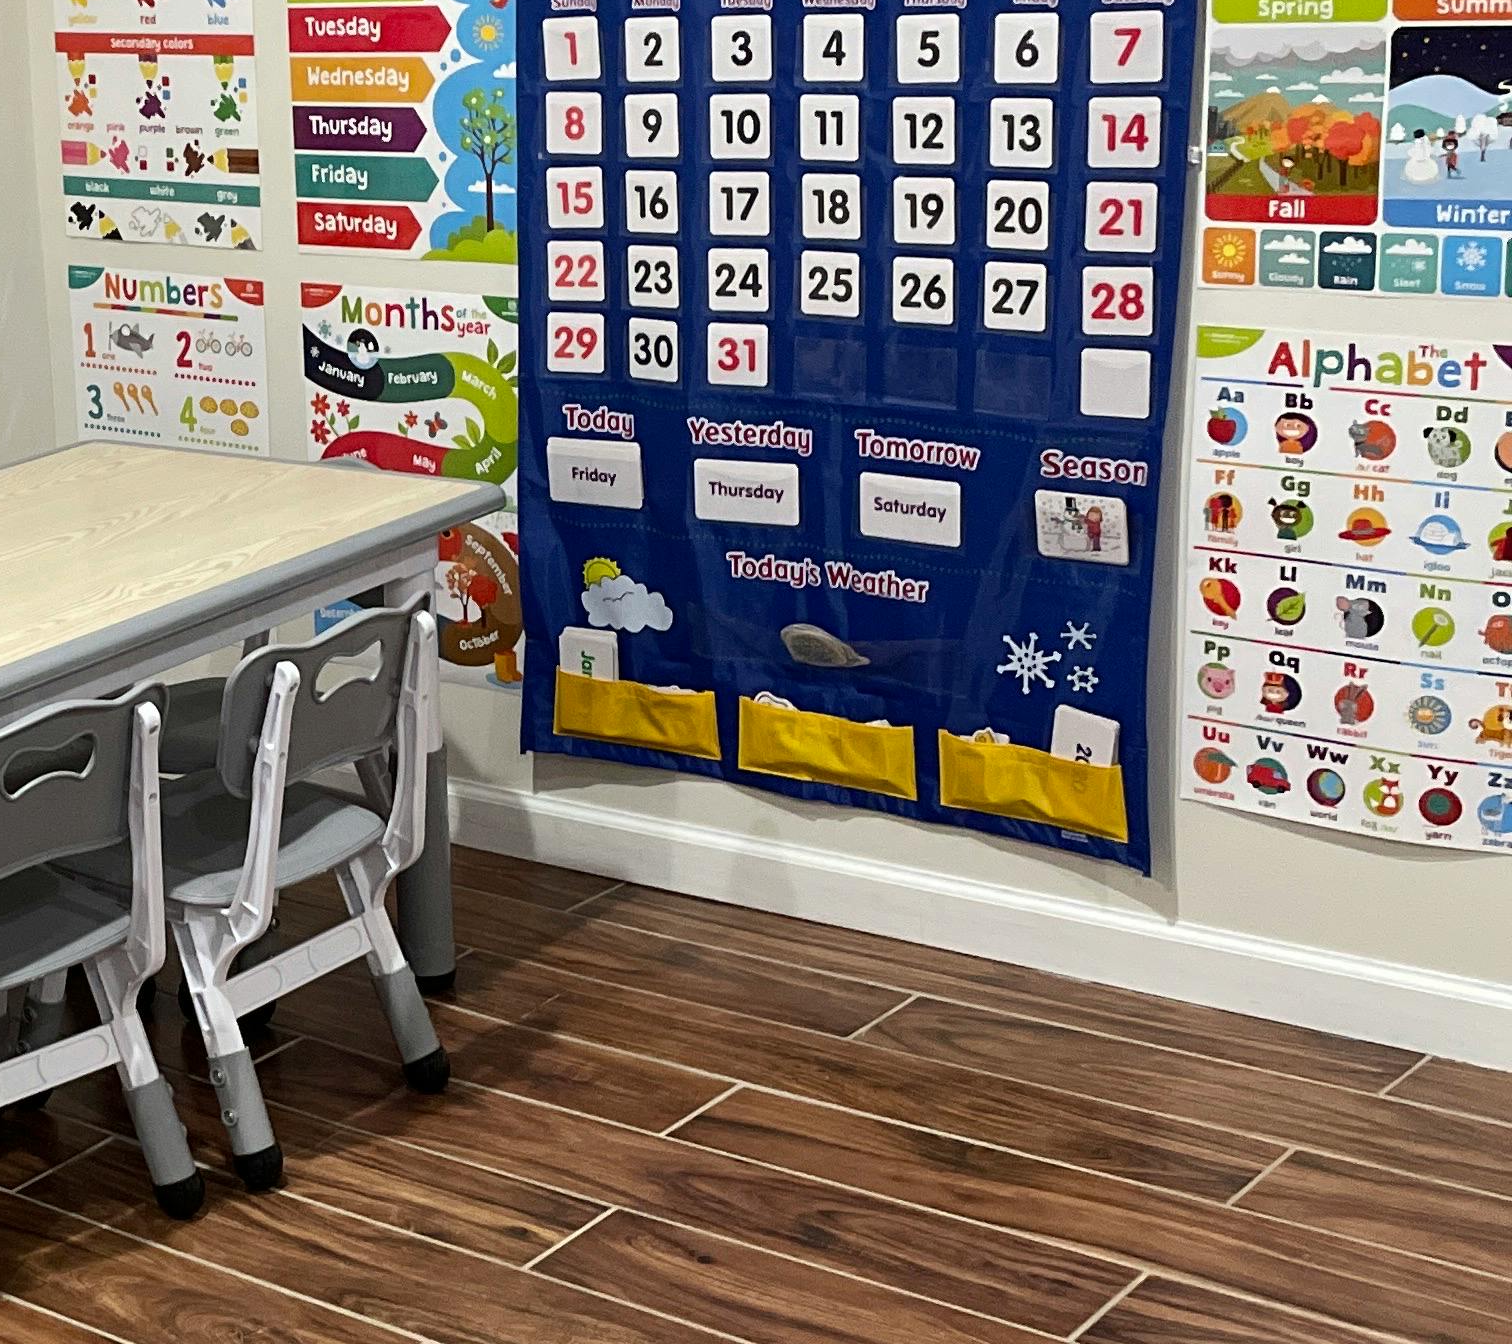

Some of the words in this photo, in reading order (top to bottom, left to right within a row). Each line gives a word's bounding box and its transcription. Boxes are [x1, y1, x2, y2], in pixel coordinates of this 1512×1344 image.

[140, 15, 156, 25] red
[207, 14, 229, 25] blue
[1258, 0, 1333, 19] Spring
[163, 38, 194, 50] colors
[305, 16, 381, 43] Tuesday
[564, 32, 577, 65] 1
[644, 32, 663, 66] 2
[731, 31, 752, 66] 3
[823, 30, 846, 66] 4
[917, 30, 940, 67] 5
[1015, 30, 1039, 67] 6
[1114, 28, 1141, 66] 7
[307, 66, 410, 93] Wednesday
[139, 124, 166, 136] purple
[175, 125, 203, 135] brown
[215, 126, 239, 138] green
[309, 115, 393, 143] Thursday
[565, 106, 584, 140] 8
[643, 109, 661, 142] 9
[720, 109, 761, 144] 10
[815, 110, 842, 145] 11
[904, 113, 944, 149] 12
[1002, 114, 1041, 151] 13
[1102, 114, 1148, 151] 14
[85, 182, 110, 194] black
[149, 185, 176, 197] white
[311, 164, 368, 191] Friday
[314, 212, 397, 239] Saturday
[556, 182, 593, 214] 15
[634, 186, 669, 220] 16
[721, 186, 758, 221] 17
[813, 189, 849, 224] 18
[905, 192, 944, 228] 19
[994, 197, 1042, 234] 20
[1100, 199, 1142, 236] 21
[1268, 199, 1305, 219] Fall
[1436, 204, 1511, 224] Winter
[105, 272, 223, 308] Numbers
[555, 255, 598, 288] 22
[634, 261, 673, 294] 23
[715, 264, 762, 297] 24
[809, 267, 852, 302] 25
[900, 273, 946, 309] 26
[992, 278, 1038, 315] 27
[1092, 284, 1145, 320] 28
[342, 296, 454, 331] Months
[456, 308, 467, 319] of
[457, 321, 491, 338] year
[83, 323, 96, 357] 1
[176, 331, 192, 368] 2
[554, 327, 598, 359] 29
[634, 335, 673, 368] 30
[717, 337, 757, 371] 31
[1419, 344, 1448, 358] The
[318, 361, 365, 387] January
[388, 371, 438, 385] February
[461, 370, 497, 400] March
[1268, 339, 1487, 391] Alphabet
[87, 385, 103, 419] 3
[180, 396, 197, 432] 4
[1217, 387, 1245, 403] Aa
[1285, 393, 1313, 410] Bb
[1365, 399, 1391, 417] Cc
[1436, 406, 1469, 424] Dd
[413, 454, 435, 473] May
[475, 447, 501, 474] April
[564, 405, 634, 439] Today
[688, 418, 812, 456] Yesterday
[855, 430, 980, 470] Tomorrow
[1041, 450, 1148, 486] Season
[572, 467, 616, 486] Friday
[709, 481, 784, 503] Thursday
[874, 497, 946, 523] Saturday
[465, 535, 512, 595] September
[727, 552, 820, 588] Today's
[826, 561, 929, 603] Weather
